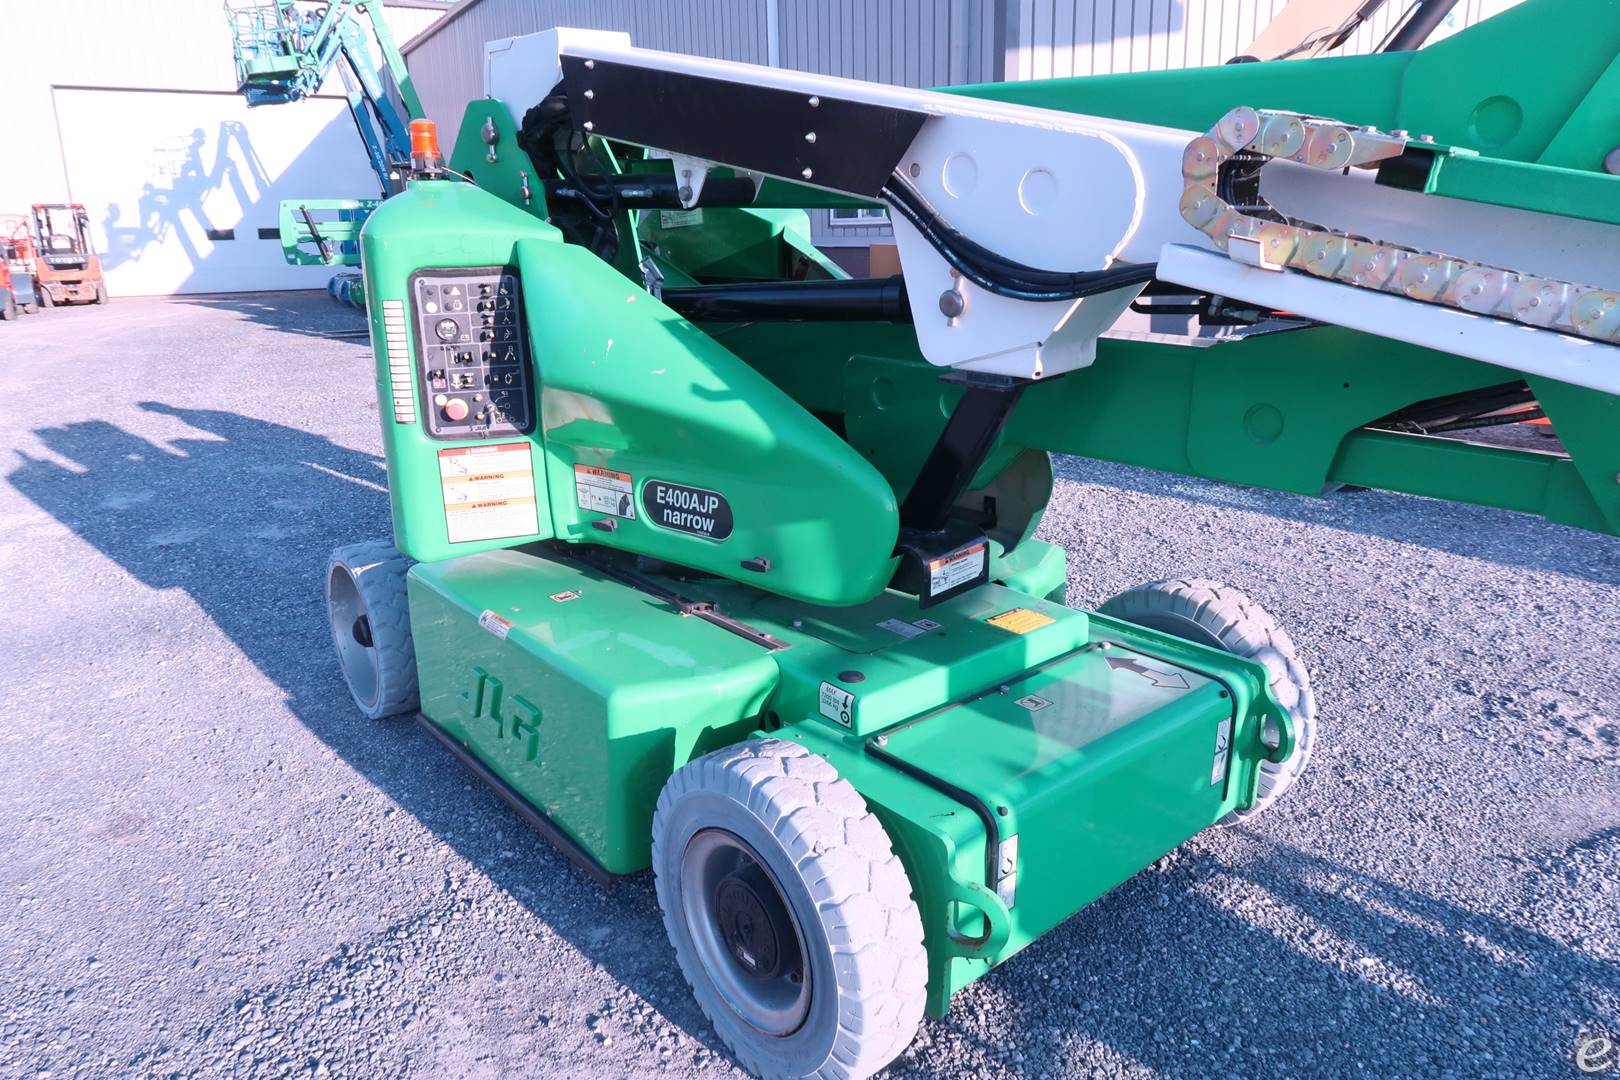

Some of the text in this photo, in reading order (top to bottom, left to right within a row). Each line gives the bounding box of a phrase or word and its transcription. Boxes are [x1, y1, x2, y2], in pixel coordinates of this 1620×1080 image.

[474, 473, 505, 481] WARNING
[592, 468, 620, 480] WARNING
[477, 500, 508, 508] WARNING
[656, 485, 719, 514] E400AJP
[663, 508, 715, 532] narrow
